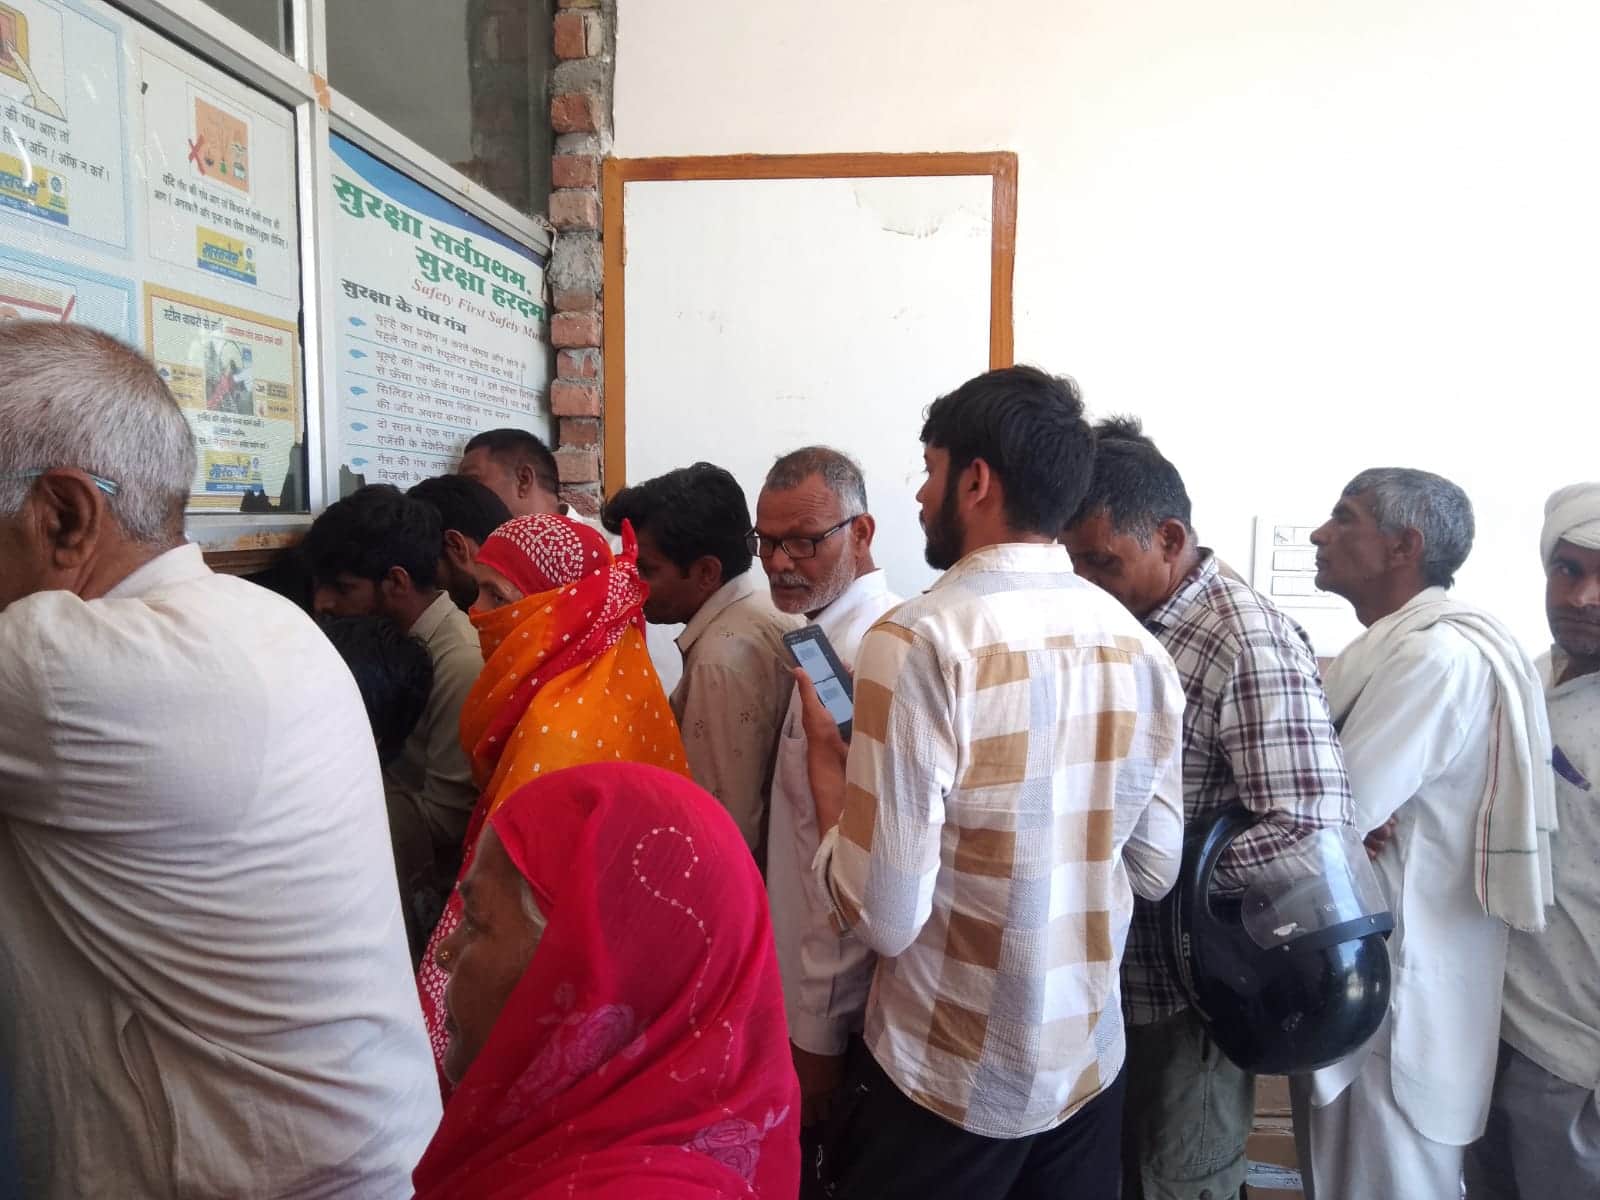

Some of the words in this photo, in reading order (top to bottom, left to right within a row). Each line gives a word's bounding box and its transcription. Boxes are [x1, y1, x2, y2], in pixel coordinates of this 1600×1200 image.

[332, 174, 423, 240] सुरक्षा
[341, 278, 391, 307] सुरक्षा
[395, 296, 413, 315] के
[415, 246, 485, 297] सुरक्षा
[412, 278, 454, 306] Safety
[458, 298, 487, 320] First
[488, 311, 520, 334] Safety
